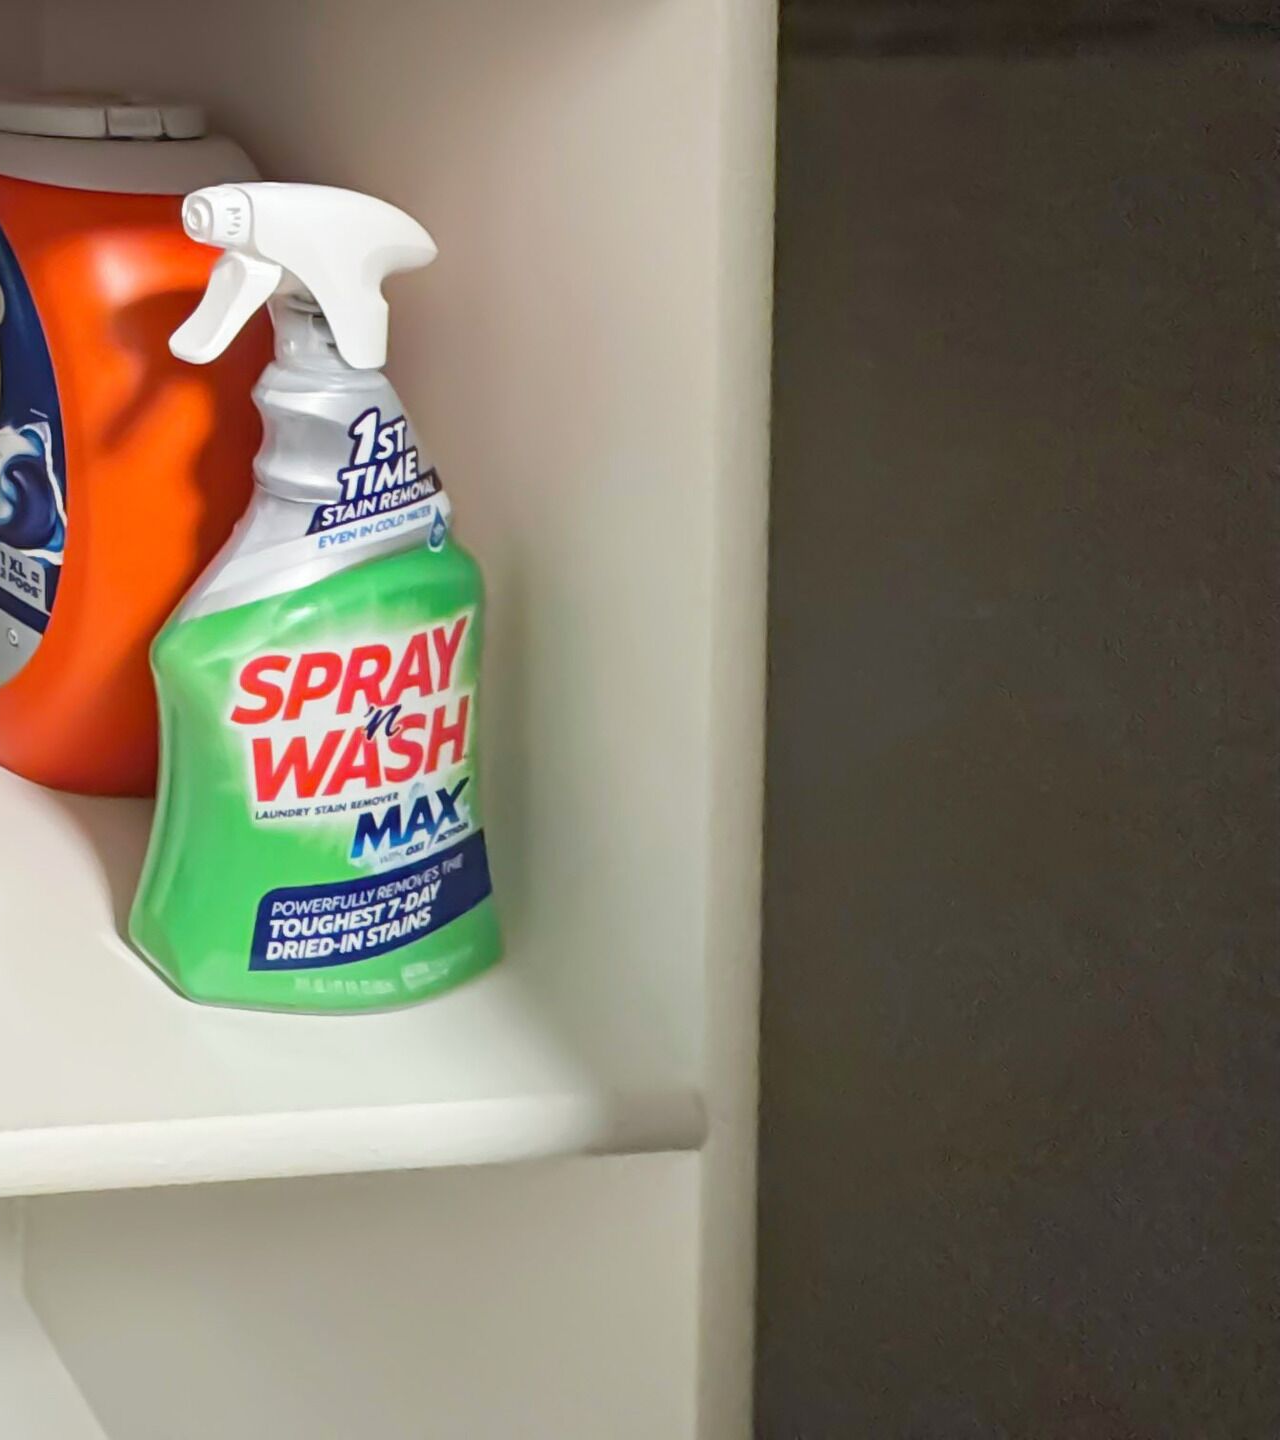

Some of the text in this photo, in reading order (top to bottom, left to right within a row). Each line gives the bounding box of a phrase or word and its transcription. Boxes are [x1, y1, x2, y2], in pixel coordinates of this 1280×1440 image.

[352, 410, 407, 465] 1ST
[321, 475, 436, 527] STAIN REMOVAL
[341, 450, 418, 502] TIME
[318, 527, 357, 549] EVEN
[359, 522, 373, 536] IN
[375, 514, 405, 533] COLD
[230, 616, 469, 725] SPRAY
[251, 695, 471, 803] WASH
[255, 791, 400, 821] LAUNDRY STAIN REMOVER
[351, 776, 470, 859] MAX
[269, 879, 443, 938] TOUGHEST 7-DAY
[271, 852, 464, 917] POWERFULLY REMOVES THE
[265, 906, 432, 960] DRIED-IN STAINS
